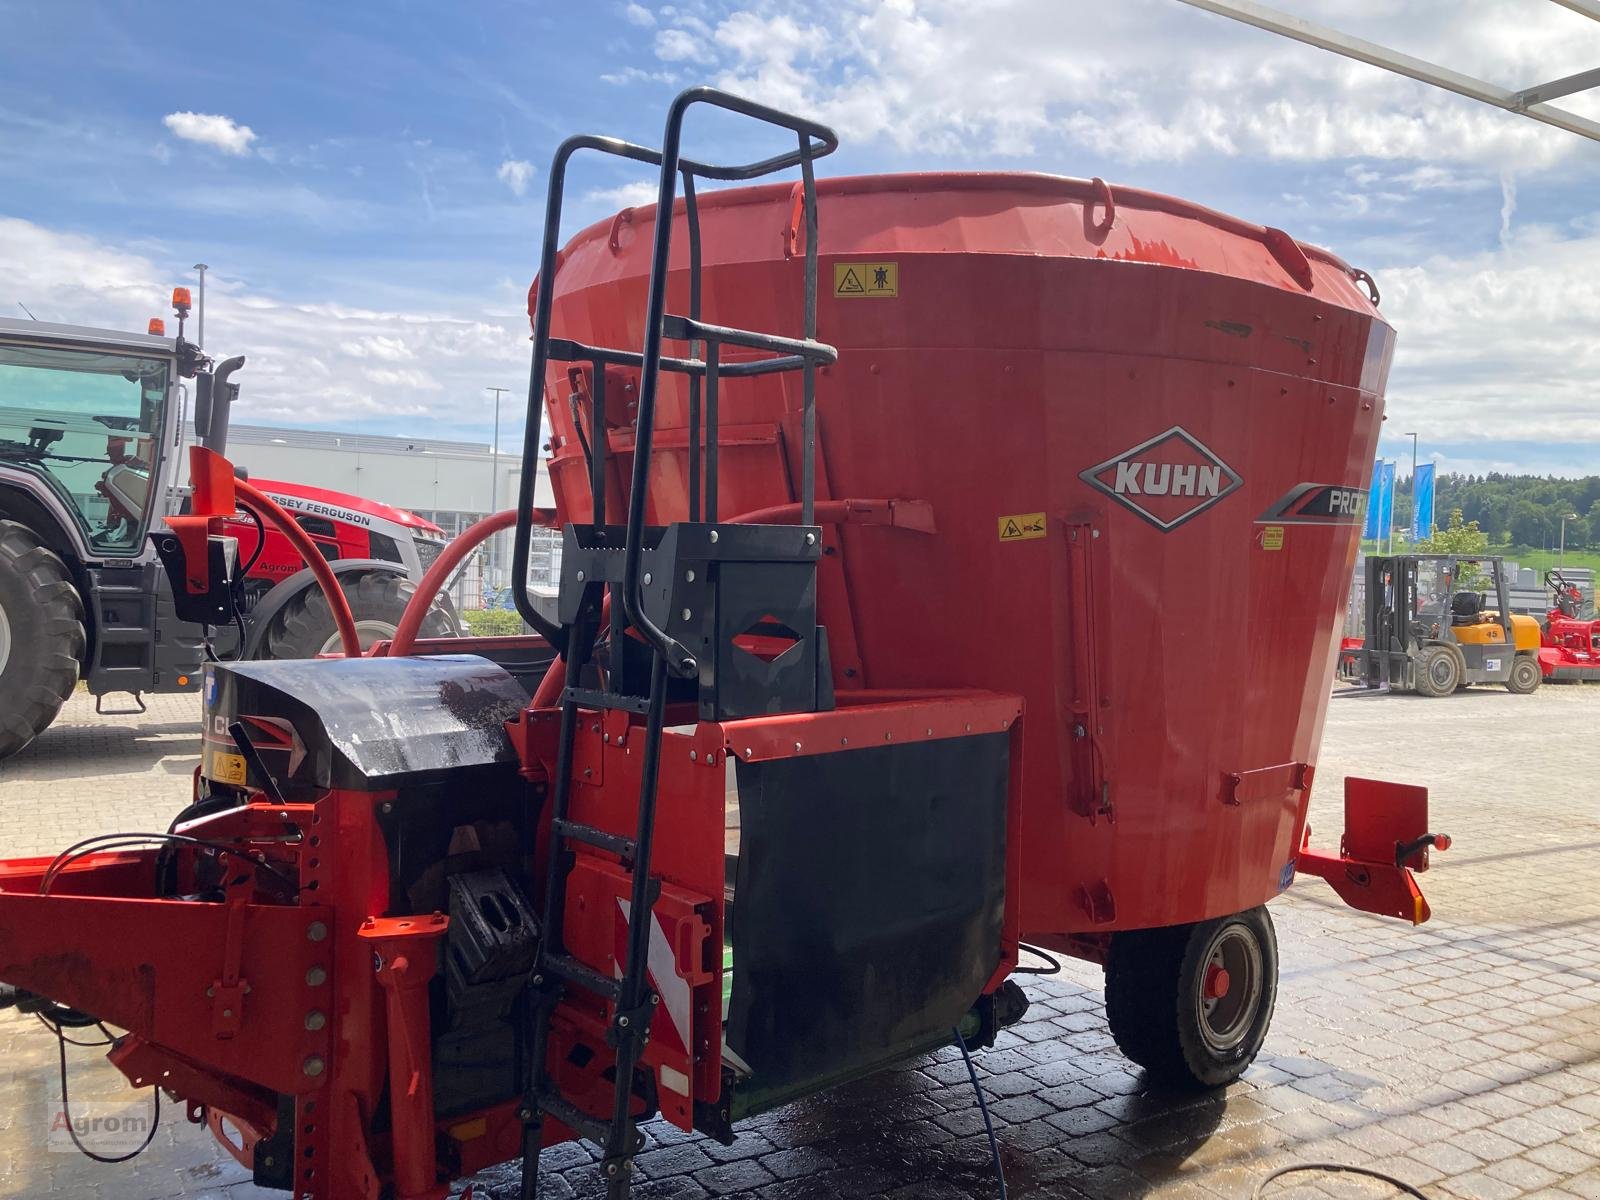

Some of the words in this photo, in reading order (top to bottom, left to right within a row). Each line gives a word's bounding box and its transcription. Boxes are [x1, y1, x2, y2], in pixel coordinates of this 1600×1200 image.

[1114, 461, 1221, 497] KUHN
[306, 503, 371, 527] FERGUSON
[260, 562, 298, 574] Agrom
